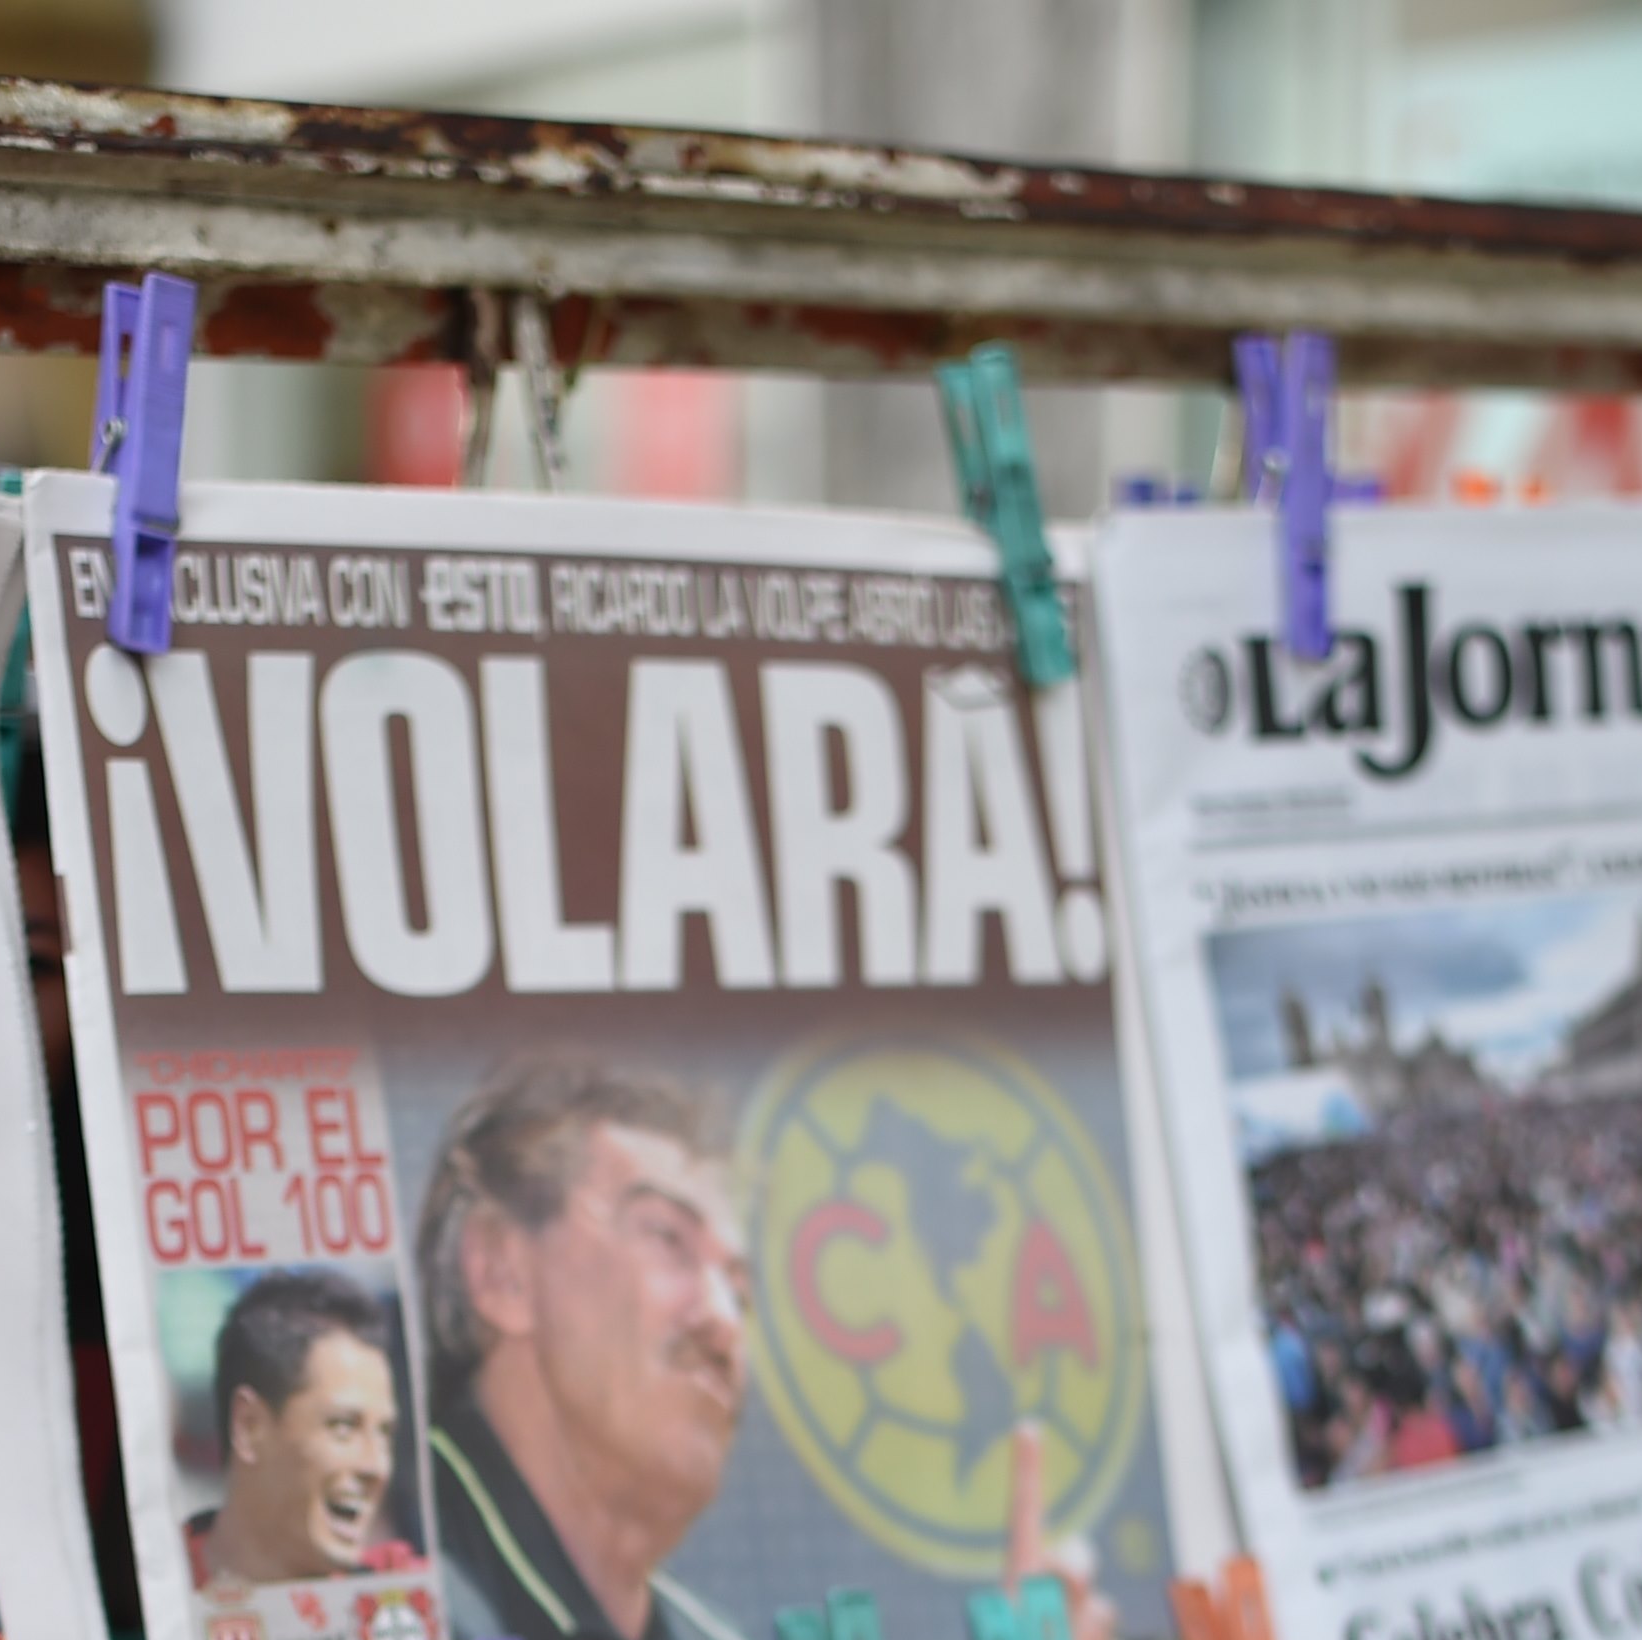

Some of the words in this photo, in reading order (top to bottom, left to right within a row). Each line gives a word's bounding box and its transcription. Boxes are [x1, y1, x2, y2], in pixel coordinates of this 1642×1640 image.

[328, 554, 409, 629] CON
[133, 1087, 285, 1176] POR
[304, 1088, 385, 1170] EL
[144, 1177, 267, 1264] GOL
[284, 1172, 391, 1257] 100
